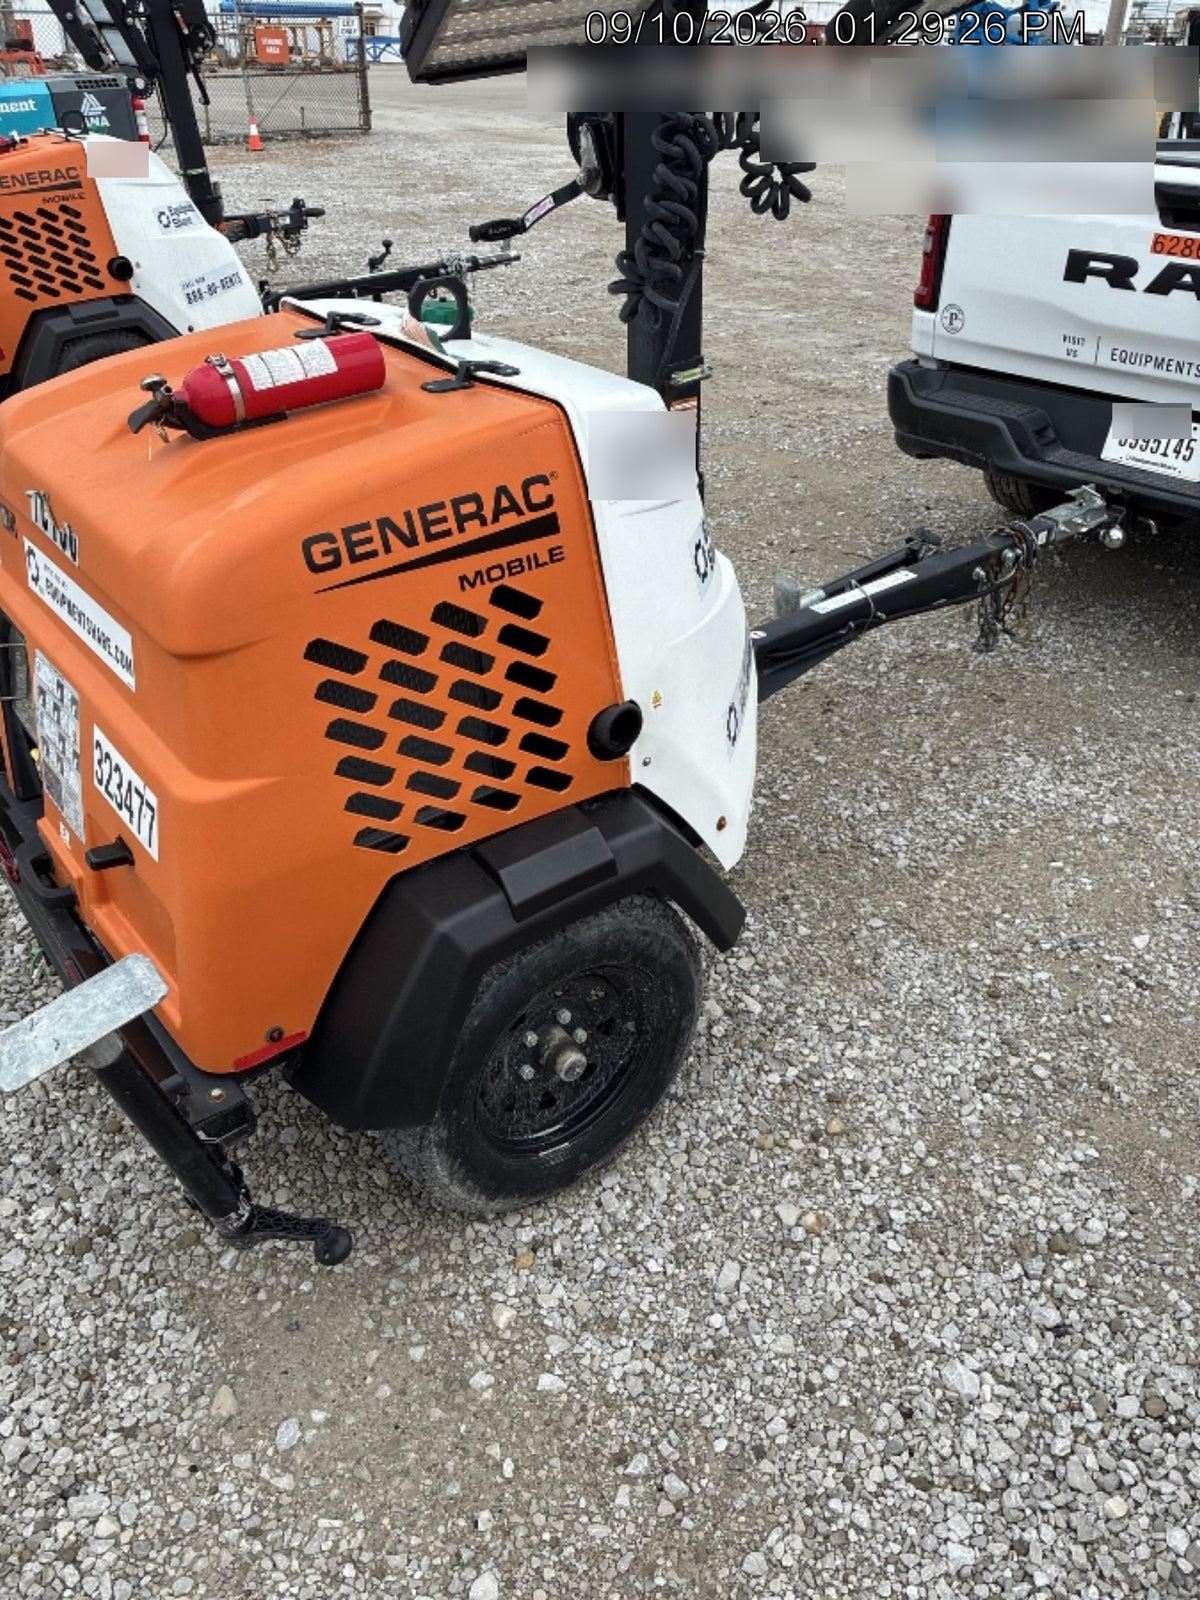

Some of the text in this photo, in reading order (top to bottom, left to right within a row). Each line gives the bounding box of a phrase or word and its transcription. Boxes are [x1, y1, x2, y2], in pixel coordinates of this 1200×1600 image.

[1153, 234, 1200, 259] 628
[1063, 248, 1200, 301] RA
[1063, 334, 1086, 346] VISIT
[1066, 348, 1078, 358] US
[301, 473, 555, 574] GENERAC
[458, 545, 565, 592] MOBILE
[45, 578, 134, 677] EQUIPMENTSHARE.COM
[95, 739, 155, 848] 323477
